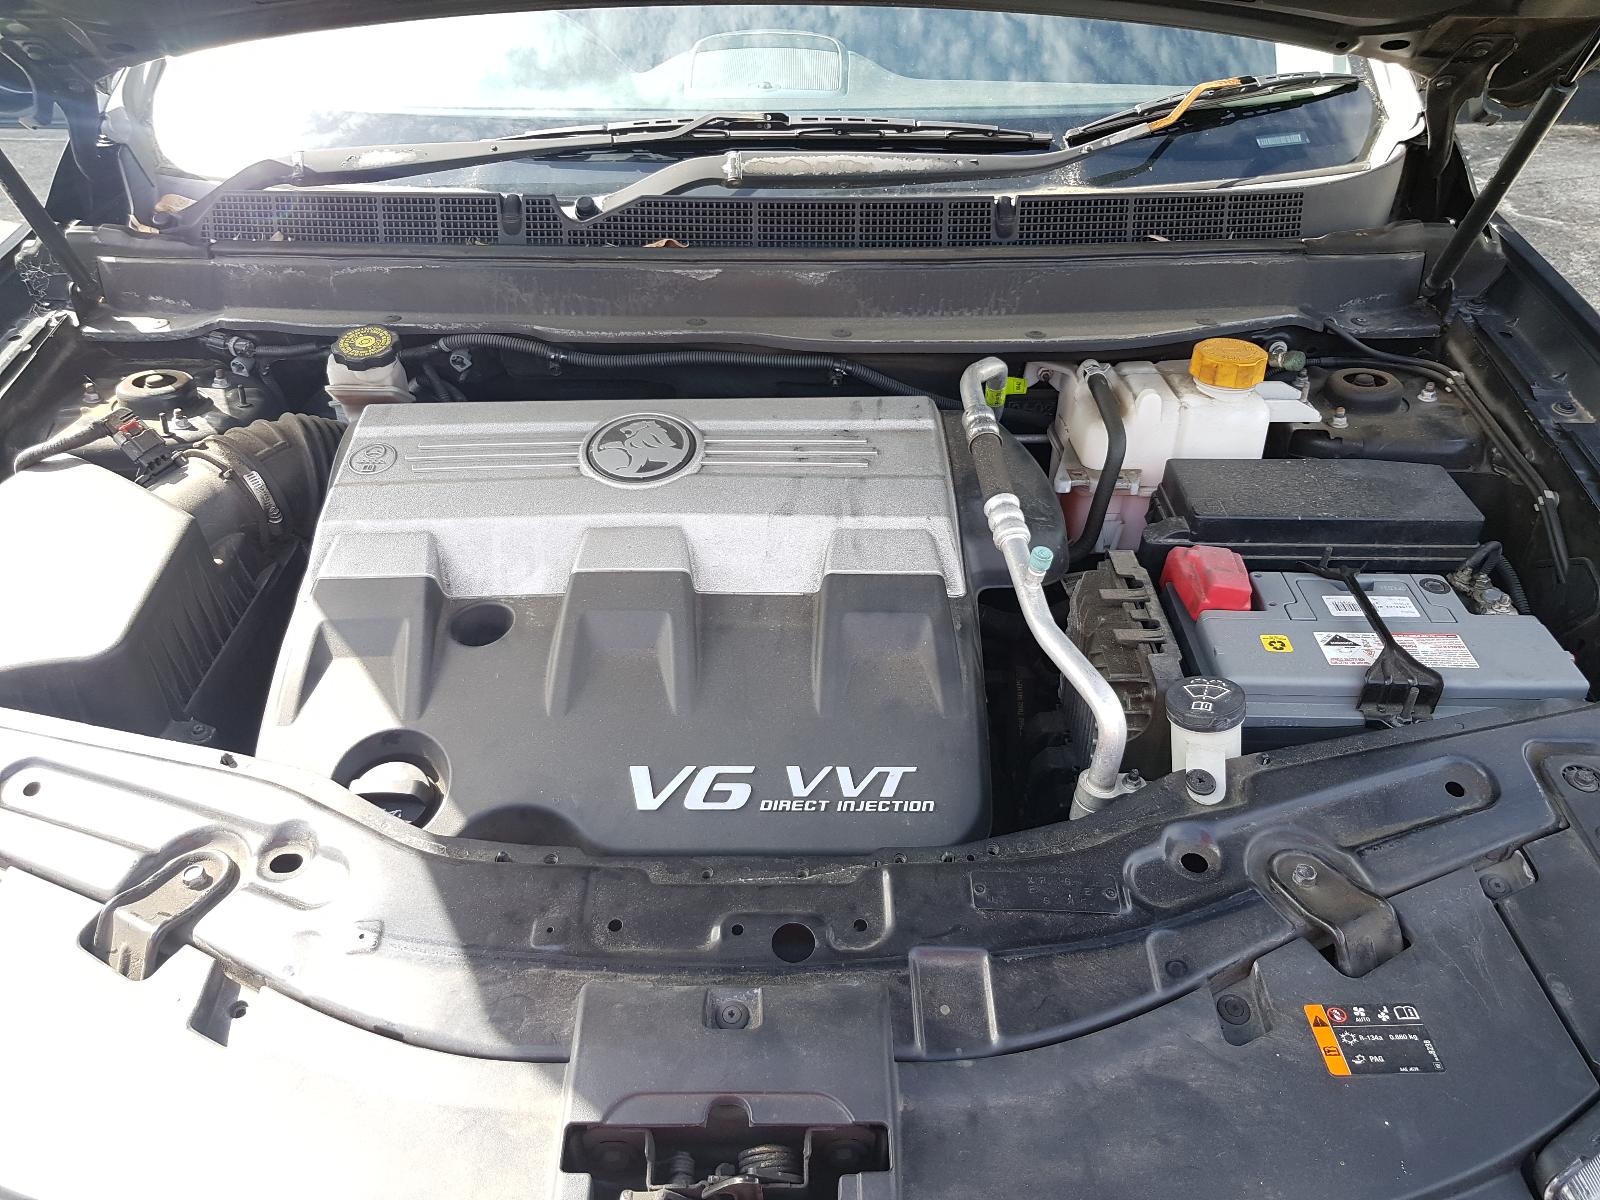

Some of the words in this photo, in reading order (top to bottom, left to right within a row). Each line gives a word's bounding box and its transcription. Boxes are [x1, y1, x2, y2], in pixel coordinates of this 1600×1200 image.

[629, 765, 756, 810] V6
[785, 765, 918, 797] VVT
[759, 800, 830, 812] DIRECT
[836, 800, 935, 812] INJECTION
